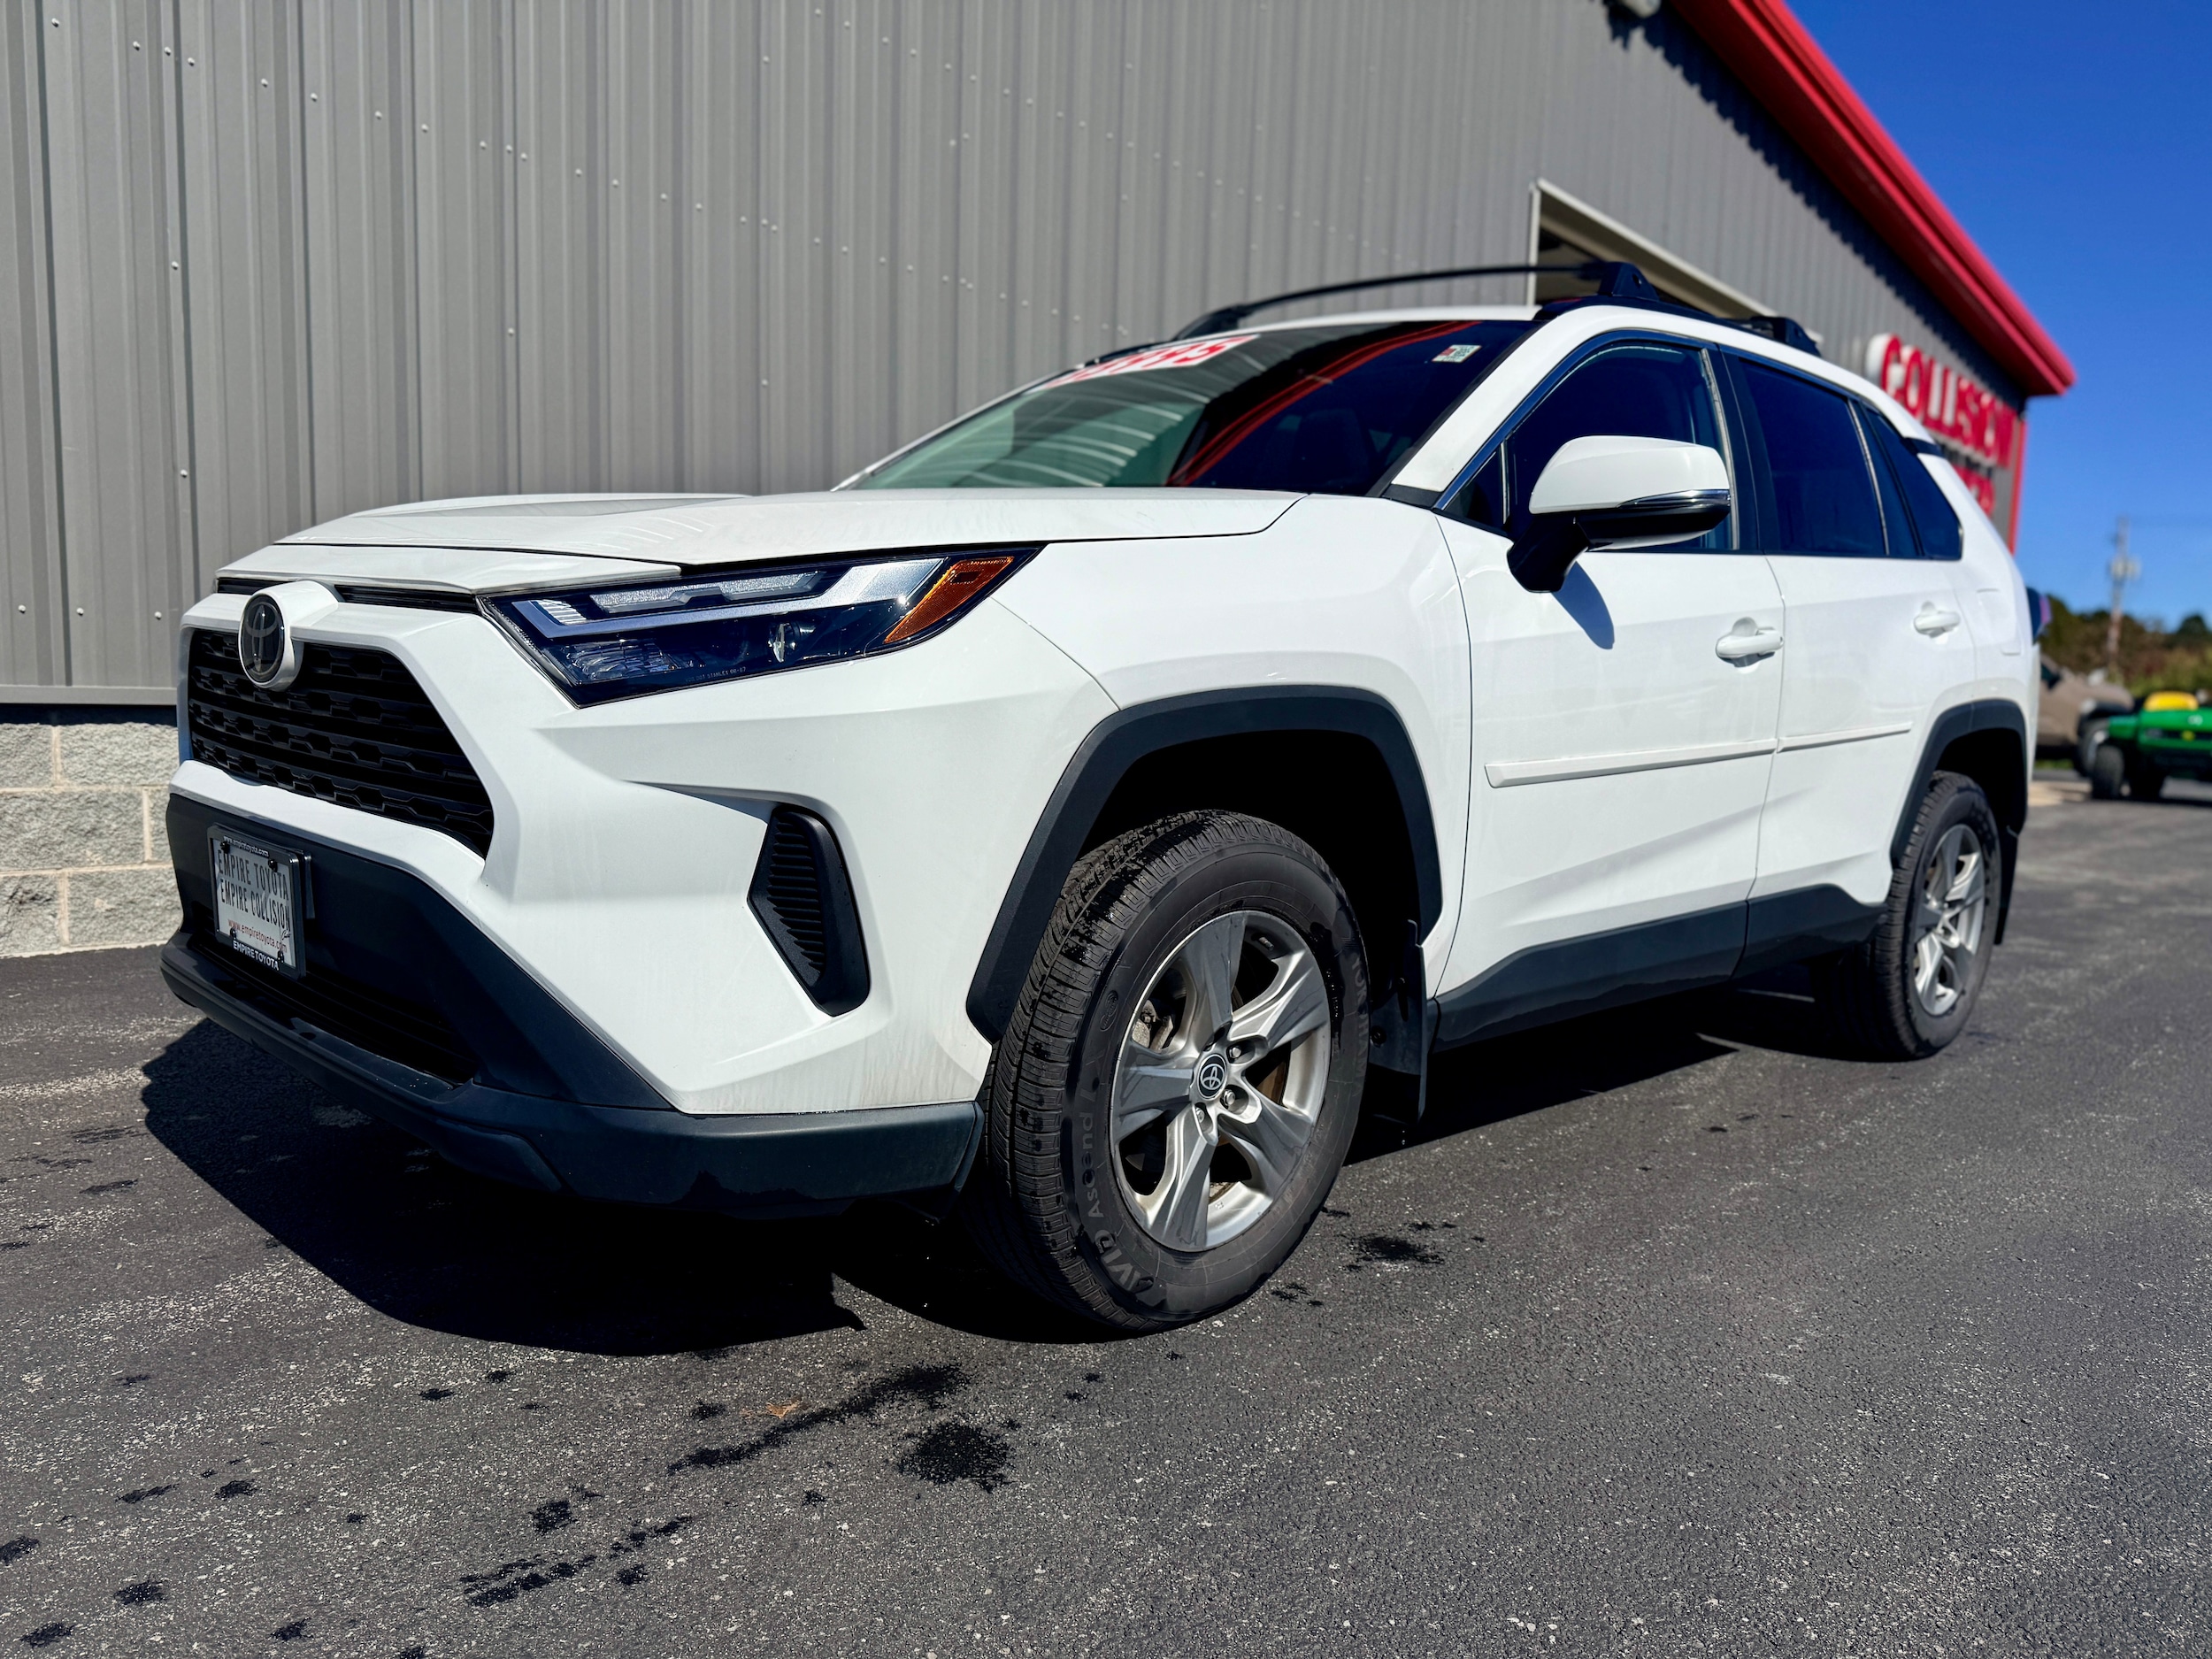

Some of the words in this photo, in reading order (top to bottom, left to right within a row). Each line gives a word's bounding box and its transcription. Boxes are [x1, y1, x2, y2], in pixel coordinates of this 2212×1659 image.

[223, 835, 270, 857] www.empiretoyota.com
[217, 849, 251, 886] EMPIRE
[253, 863, 289, 901] TOYOTA
[219, 878, 249, 913] EMPIRE
[250, 890, 291, 932] COLLISION
[227, 918, 288, 953] www.empiretoyota.com
[233, 940, 256, 959] EMPIRE
[254, 950, 280, 971] TOYOTA
[1079, 1111, 1105, 1219] Ascend
